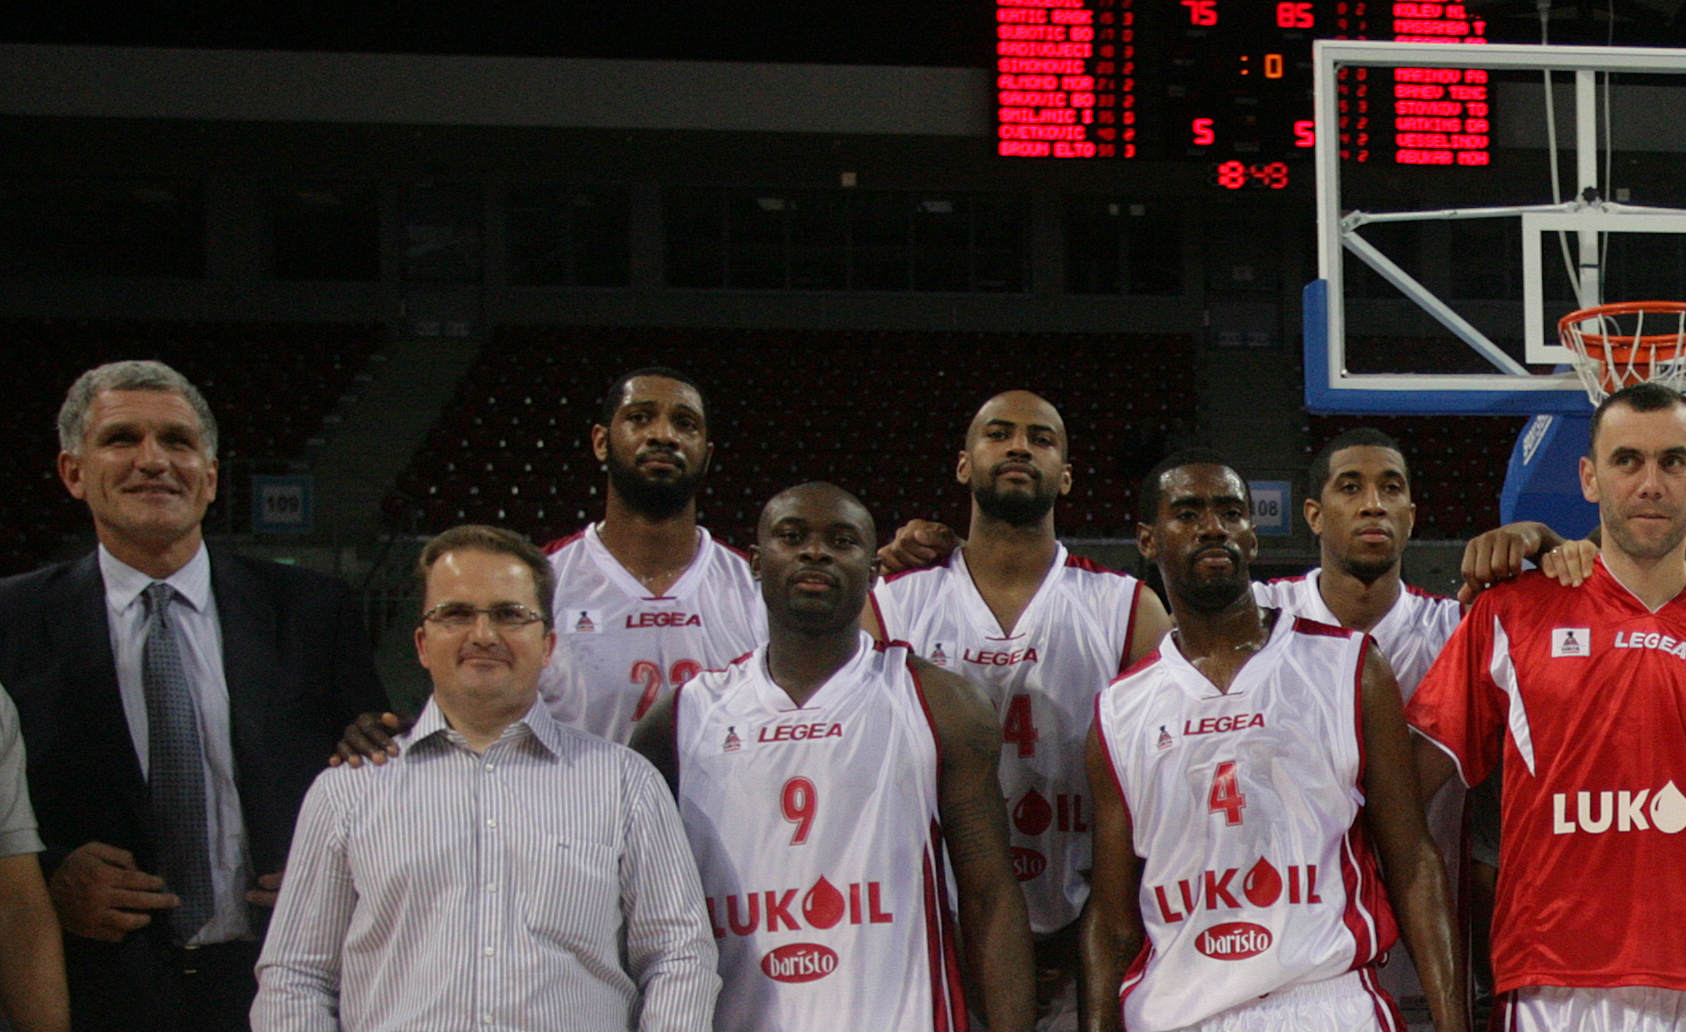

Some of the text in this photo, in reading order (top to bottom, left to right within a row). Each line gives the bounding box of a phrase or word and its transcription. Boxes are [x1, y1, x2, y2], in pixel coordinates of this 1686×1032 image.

[1180, 0, 1218, 26] 75
[1276, 2, 1315, 28] 85
[1473, 21, 1487, 35] T
[998, 58, 1085, 74] SIMONOVIC
[1394, 67, 1462, 84] MARINOV
[1192, 118, 1215, 145] 5
[1294, 120, 1315, 147] 5
[1395, 116, 1462, 132] WATKINS
[267, 495, 300, 513] 109
[625, 611, 702, 629] LEGEA
[963, 647, 1039, 667] LEGEA
[757, 723, 843, 743] LEGEA
[1183, 713, 1266, 737] LEGEA
[1208, 760, 1246, 827] 4
[780, 775, 818, 847] 9
[1008, 787, 1087, 836] OIL
[706, 875, 893, 940] LUKOIL
